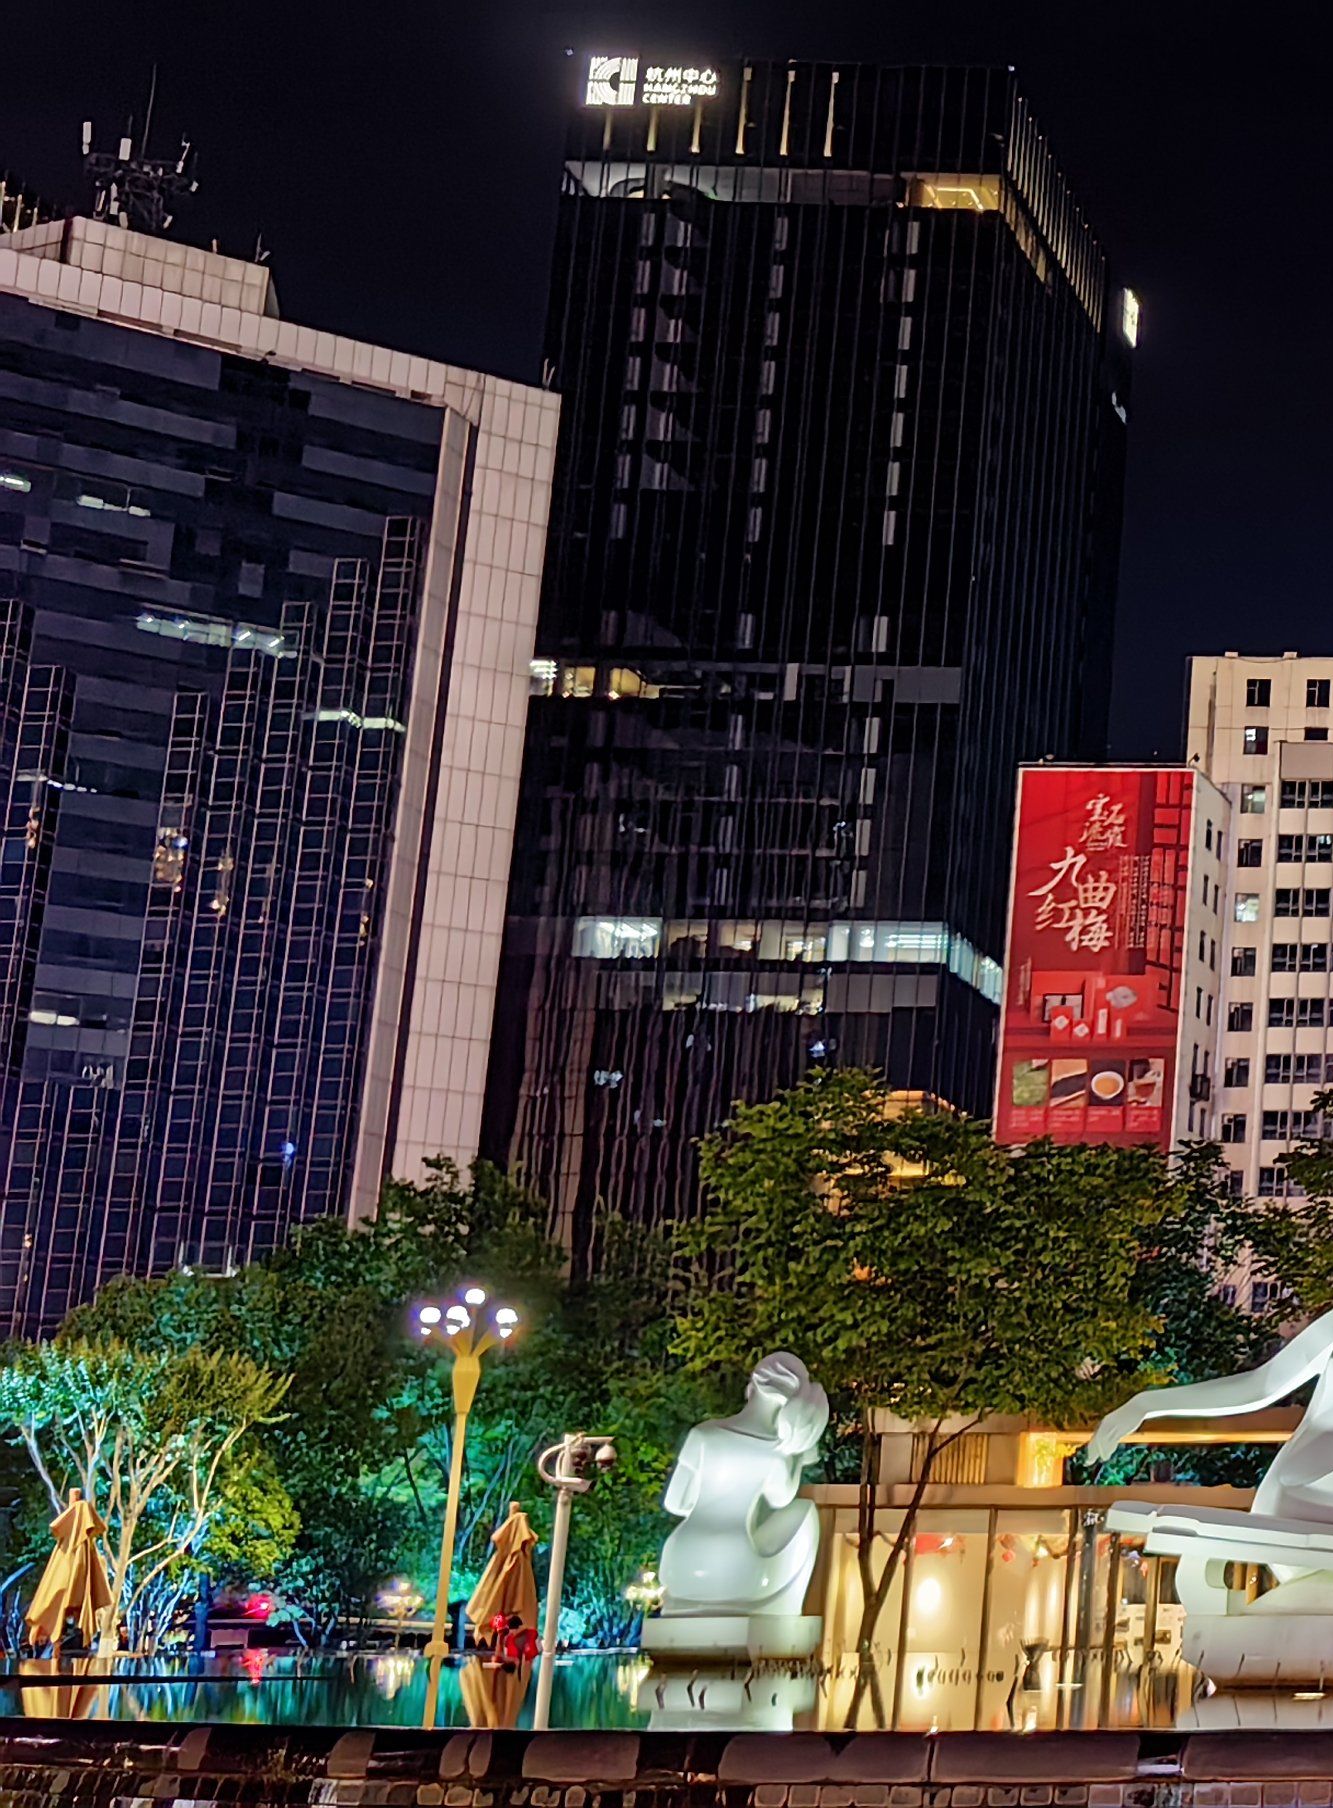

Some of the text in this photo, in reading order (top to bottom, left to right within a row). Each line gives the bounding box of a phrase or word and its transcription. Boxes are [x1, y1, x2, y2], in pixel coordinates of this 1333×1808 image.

[646, 66, 717, 84] 杭州中心
[642, 93, 692, 105] CENTER
